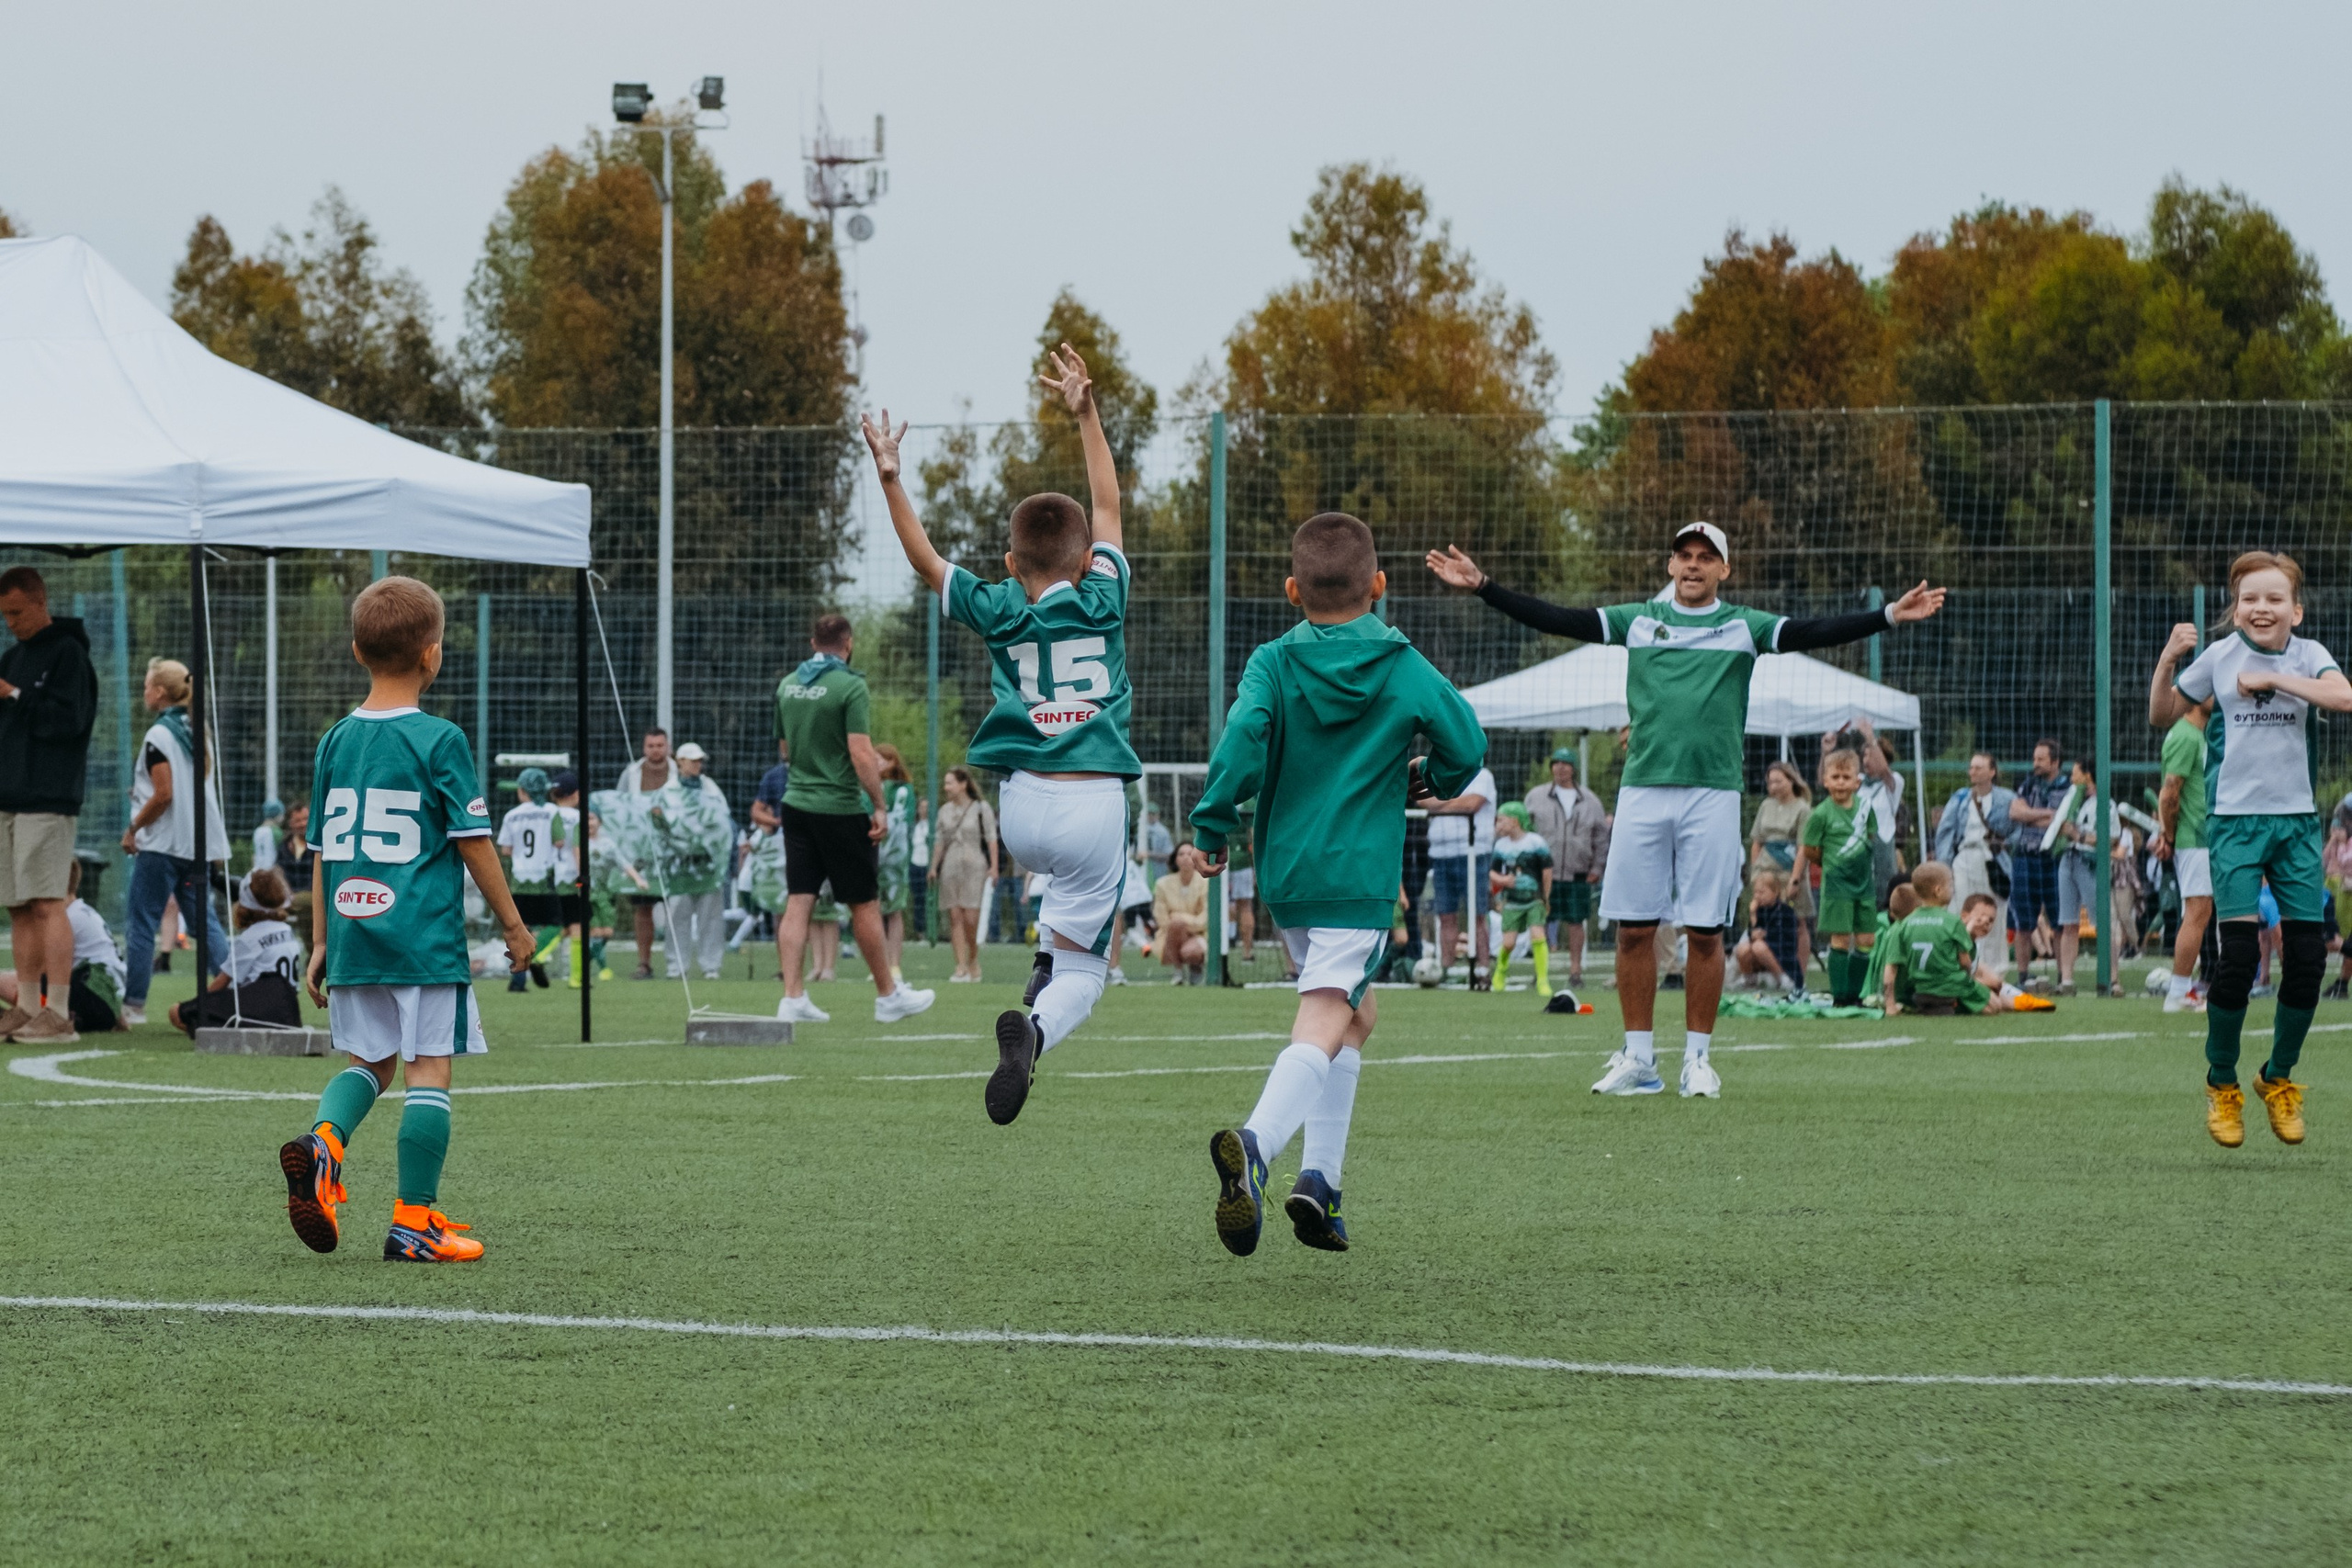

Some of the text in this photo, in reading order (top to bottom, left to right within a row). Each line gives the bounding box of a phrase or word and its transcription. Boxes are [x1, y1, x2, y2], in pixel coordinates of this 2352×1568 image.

[1007, 636, 1111, 702] 15
[2233, 712, 2296, 722] ФУТБОЛИКА
[322, 787, 422, 864] 25
[523, 829, 535, 858] 9
[337, 891, 388, 904] SINTEC
[1911, 942, 1933, 971] 7
